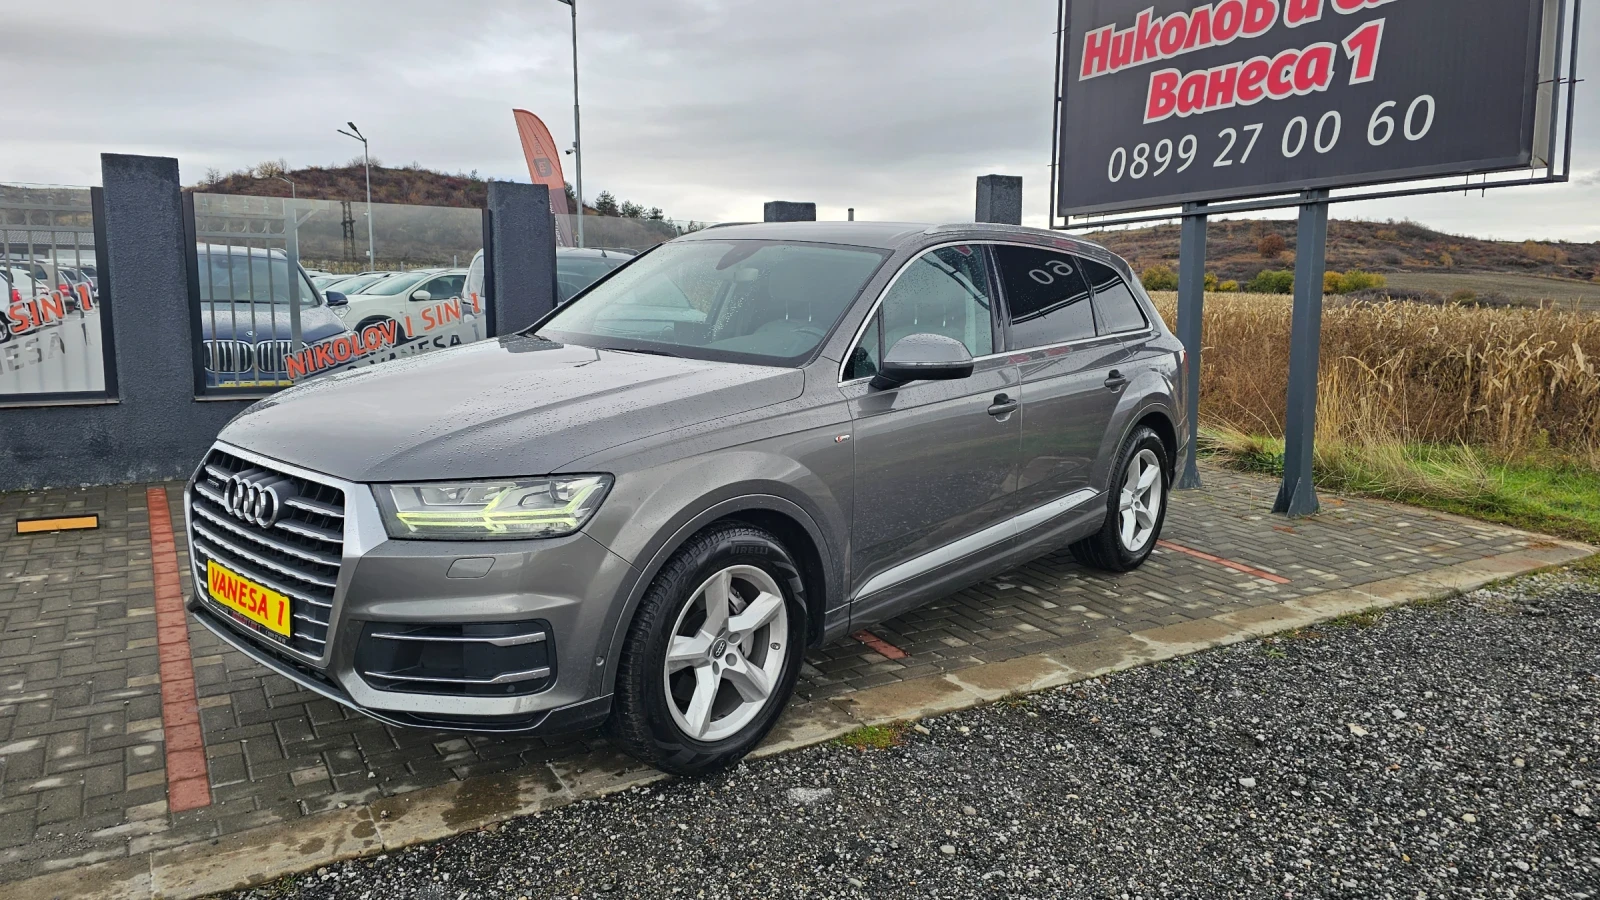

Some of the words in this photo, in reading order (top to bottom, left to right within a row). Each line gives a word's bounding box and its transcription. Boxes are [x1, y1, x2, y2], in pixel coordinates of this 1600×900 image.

[1079, 0, 1279, 81] Николов
[1143, 41, 1337, 124] Ванеса
[1341, 18, 1385, 85] 1
[1107, 134, 1198, 183] 0899
[1212, 123, 1264, 168] 27
[1281, 110, 1342, 158] 00
[1367, 94, 1436, 146] 60
[7, 291, 66, 334] SIN
[75, 283, 93, 311] 1
[285, 318, 398, 380] NIKOLOV
[403, 313, 414, 338] I
[420, 298, 462, 333] SIN
[469, 291, 482, 316] 1
[0, 331, 65, 375] ESA
[730, 540, 769, 555] PIRELLI
[211, 566, 269, 621] VANESA
[277, 600, 285, 627] 1
